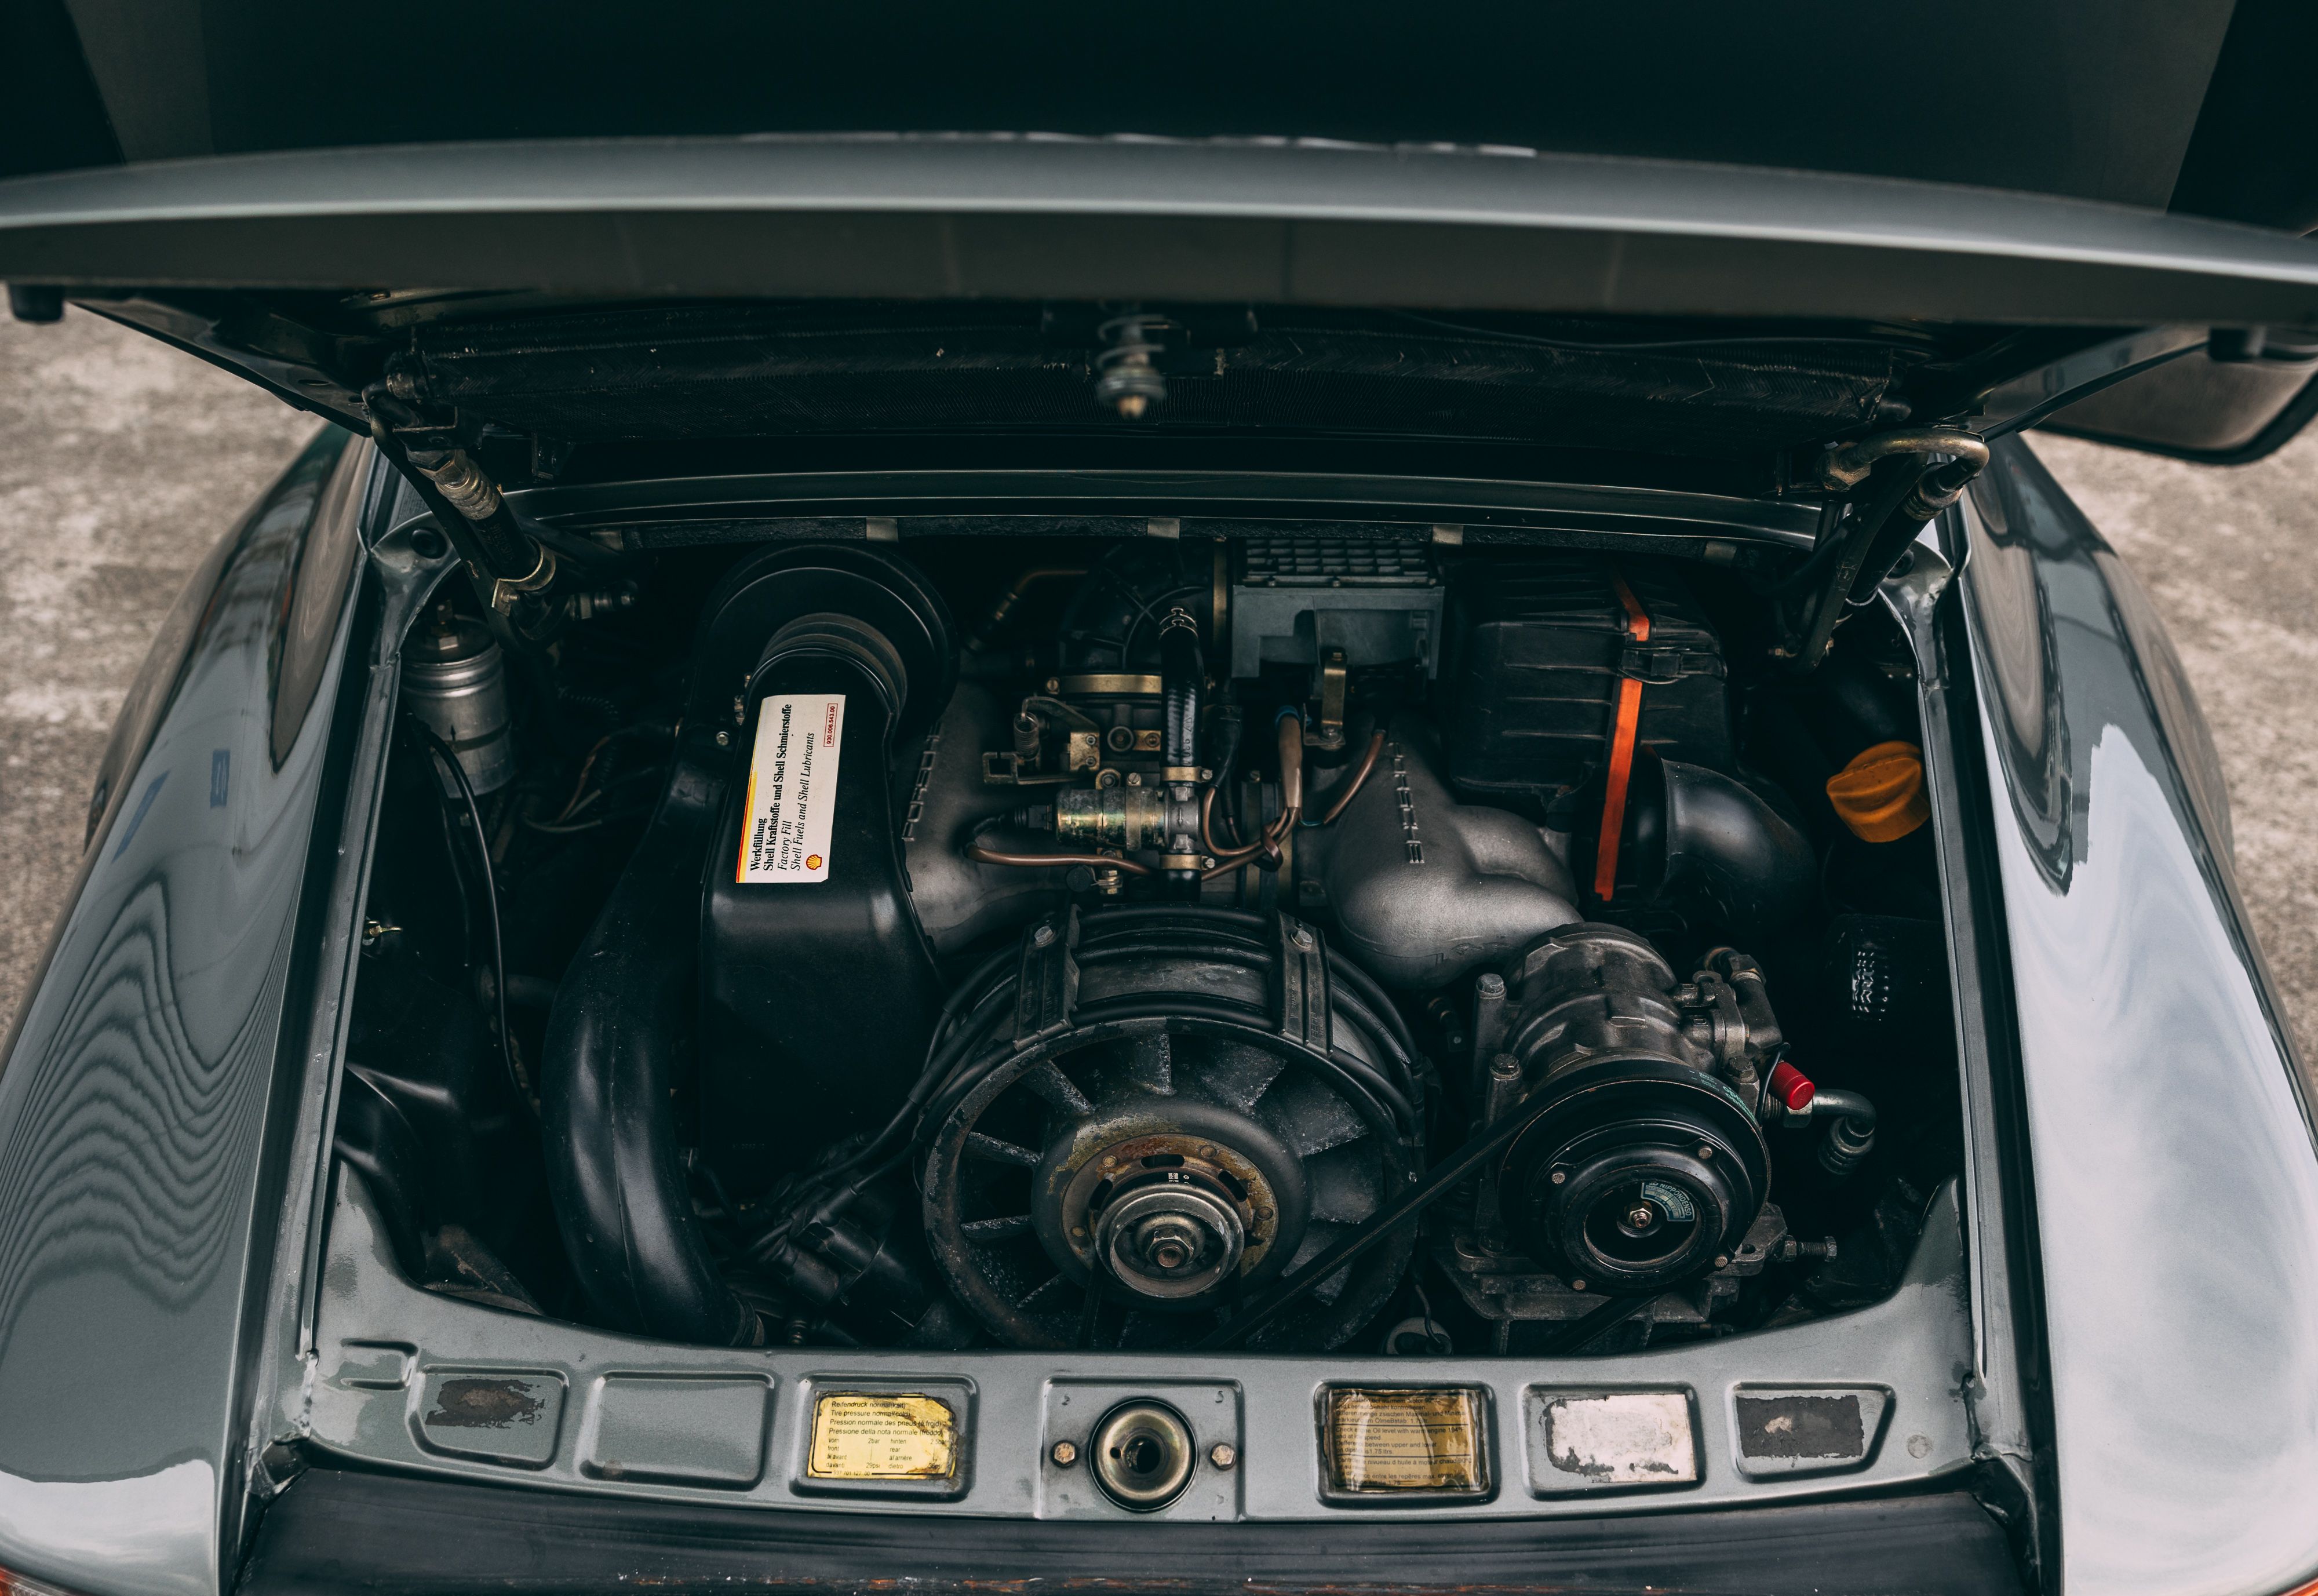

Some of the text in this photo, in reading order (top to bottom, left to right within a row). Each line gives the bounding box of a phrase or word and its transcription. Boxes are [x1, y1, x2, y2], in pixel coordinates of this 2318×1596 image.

[763, 704, 792, 871] Shell Kraftstoffe und Shell Schmierstoffe
[790, 732, 815, 871] Shell Fuels and Shell Lubricants
[750, 818, 768, 871] Werkfüllung
[777, 820, 792, 870] Factory Fill
[1659, 1183, 1692, 1216] NIPPONDENSO
